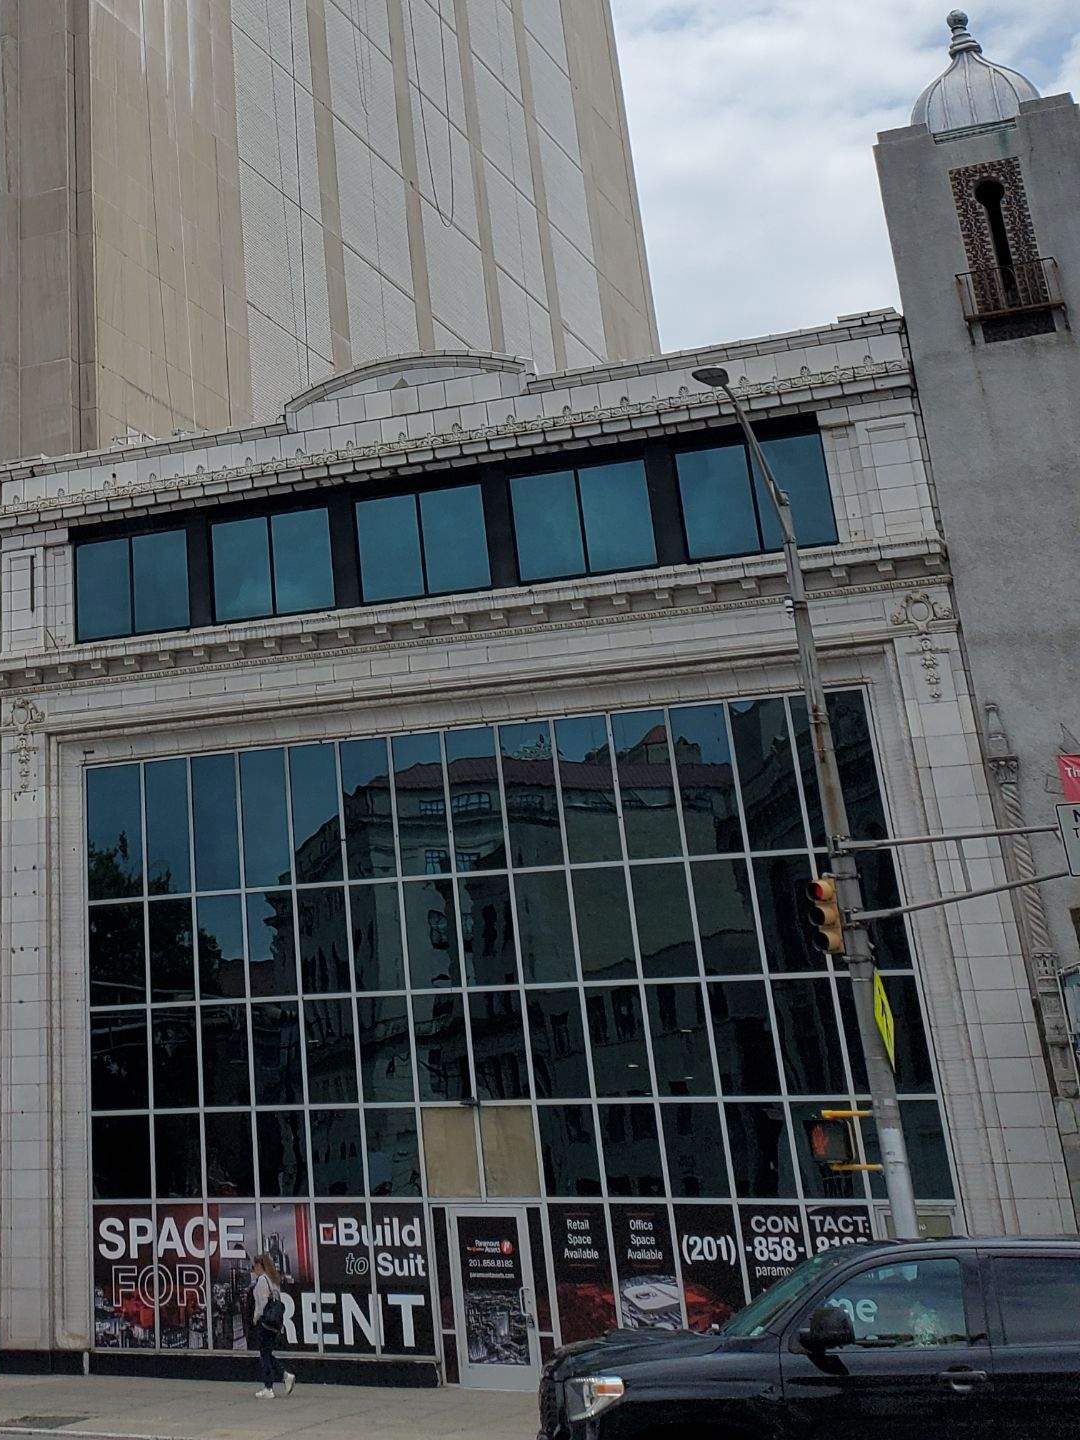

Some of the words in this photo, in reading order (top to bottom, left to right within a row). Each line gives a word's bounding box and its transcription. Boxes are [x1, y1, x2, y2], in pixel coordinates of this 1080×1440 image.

[566, 1219, 590, 1231] Retail
[629, 1220, 654, 1231] Office
[98, 1216, 247, 1260] SPACE
[337, 1217, 422, 1247] Build
[567, 1233, 592, 1246] Space
[630, 1234, 656, 1247] Space
[564, 1248, 600, 1260] Available
[627, 1248, 663, 1260] Available
[345, 1253, 369, 1275] to
[376, 1252, 426, 1277] Suit
[111, 1264, 207, 1309] FOR
